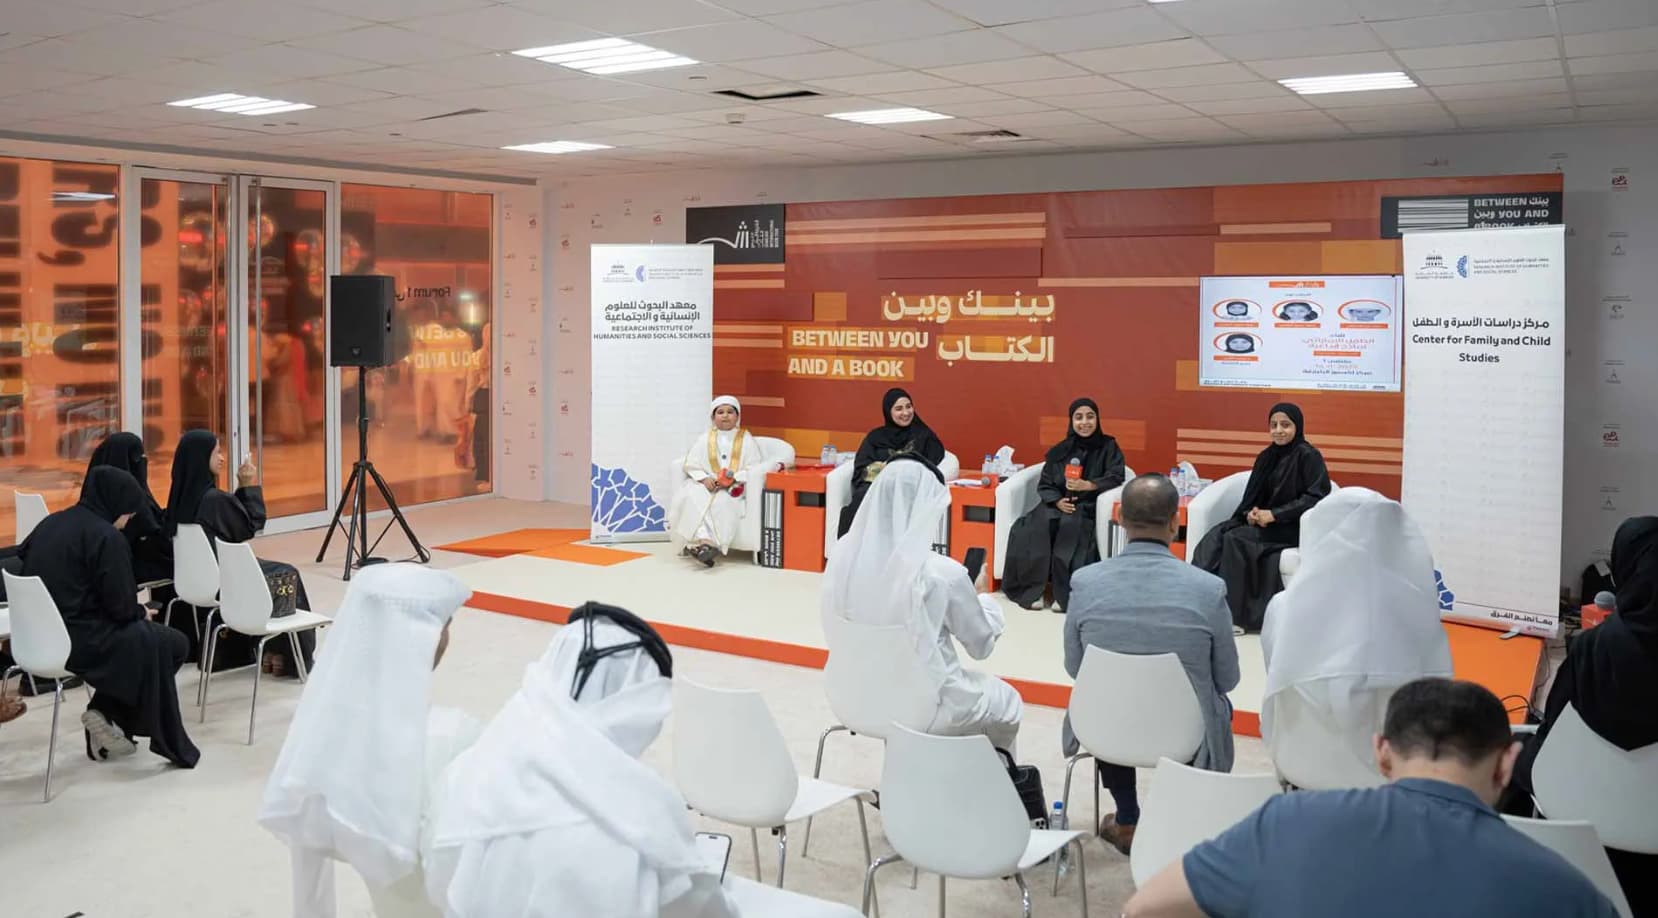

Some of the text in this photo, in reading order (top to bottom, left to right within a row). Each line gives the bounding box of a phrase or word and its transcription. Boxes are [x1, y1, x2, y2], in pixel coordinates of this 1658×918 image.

[1474, 197, 1527, 207] BETWEEN
[1498, 209, 1549, 218] YOU AND
[604, 300, 697, 311] معهد البحوث للعلوم
[883, 290, 1055, 324] بينك وبين
[604, 312, 652, 323] الاجتماعية
[660, 311, 700, 323] الإنسانية
[1412, 316, 1550, 330] مركز دراسات الأسرة و الطفل
[611, 324, 648, 332] RESEARCH
[648, 324, 683, 332] INSTITUTE
[791, 329, 929, 349] BETWEEN YOU
[1412, 334, 1551, 347] Center for Family and Child
[938, 335, 1055, 367] الكتاب
[1459, 352, 1500, 363] Studies
[787, 357, 904, 378] AND A BOOK
